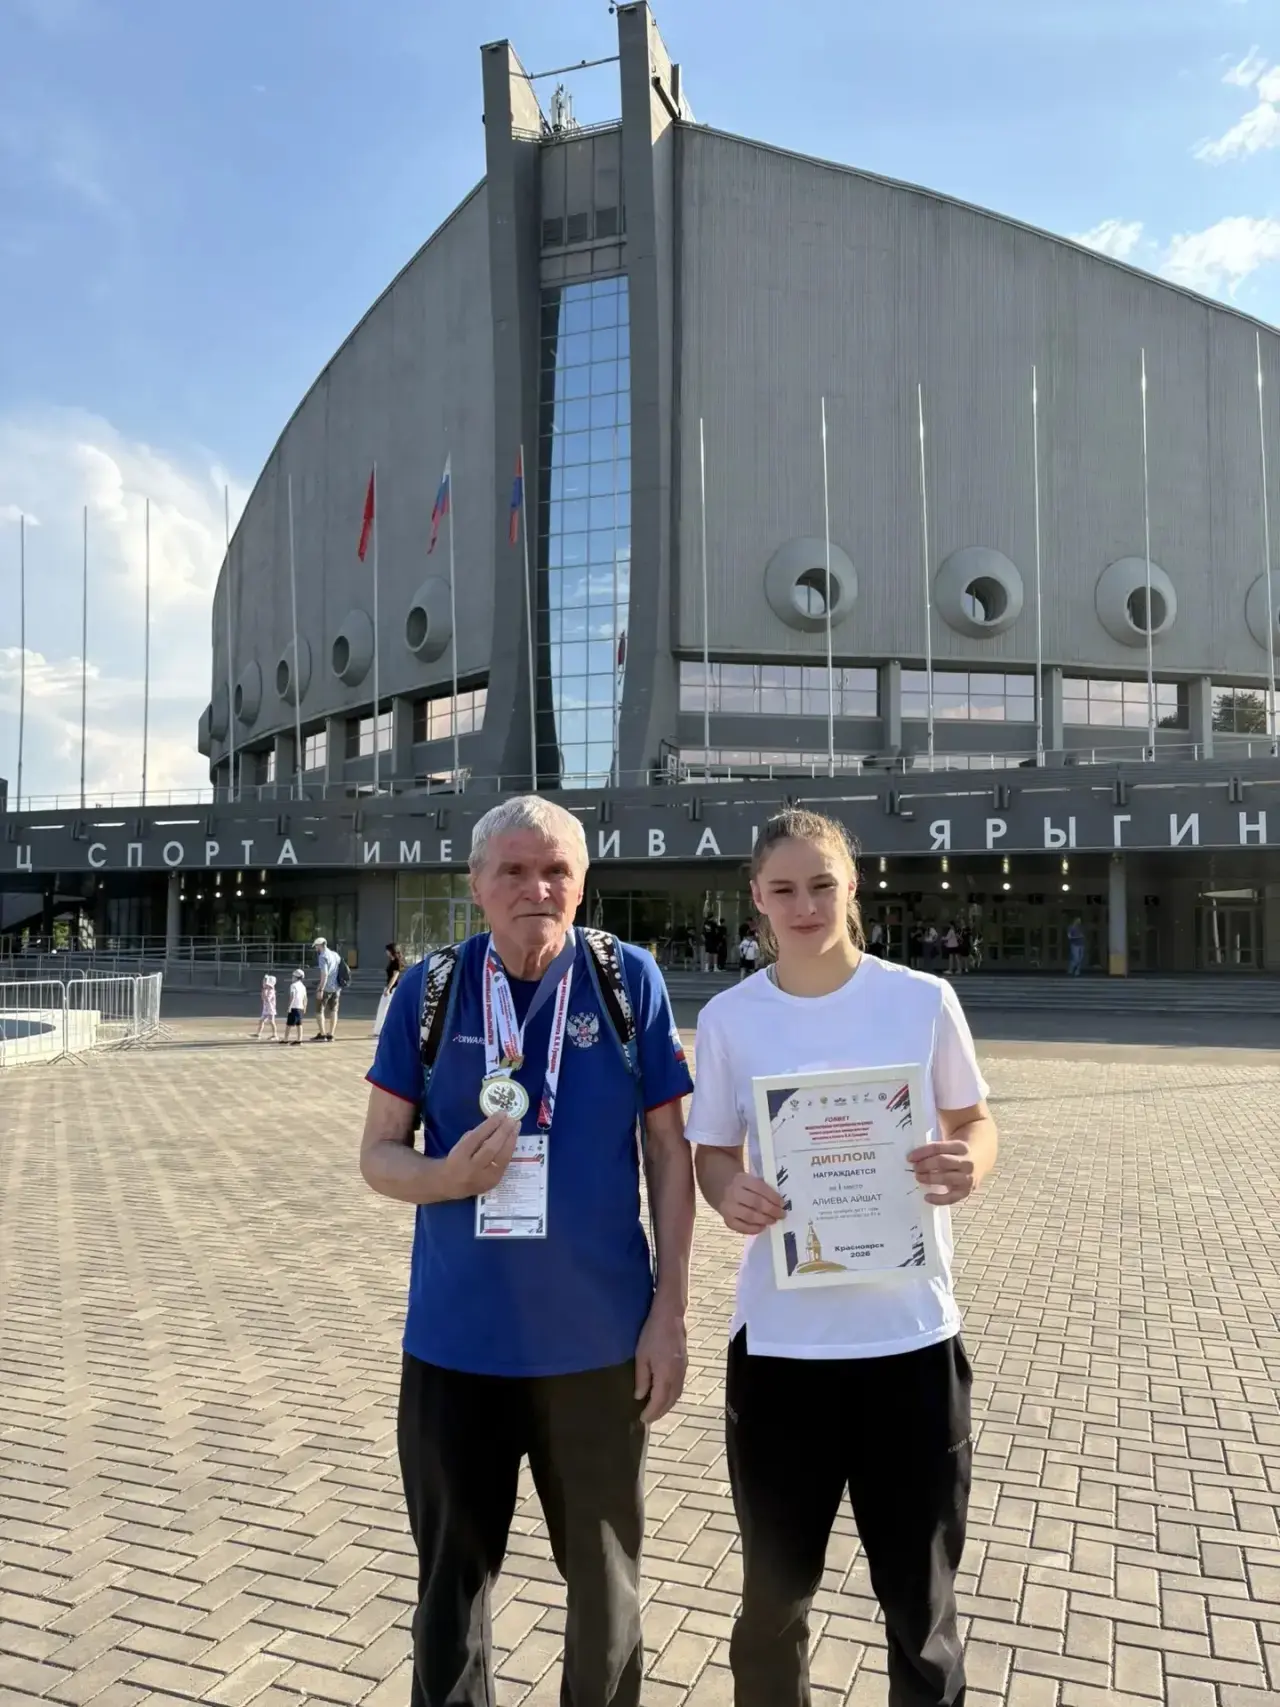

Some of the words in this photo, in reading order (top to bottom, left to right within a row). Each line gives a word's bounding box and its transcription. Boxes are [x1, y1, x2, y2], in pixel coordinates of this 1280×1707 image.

[87, 838, 299, 867] СПОРТА
[363, 838, 453, 864] ИМЕ
[598, 826, 758, 858] ИВА
[930, 811, 1268, 850] ЯРЫГИН
[811, 1151, 876, 1166] ДИПЛОМ
[813, 1168, 876, 1179] НАГРАЖДАЕТСЯ
[812, 1196, 848, 1206] АЛИЕВА
[850, 1193, 882, 1203] АЙШАТ
[834, 1243, 884, 1252] Красноярск
